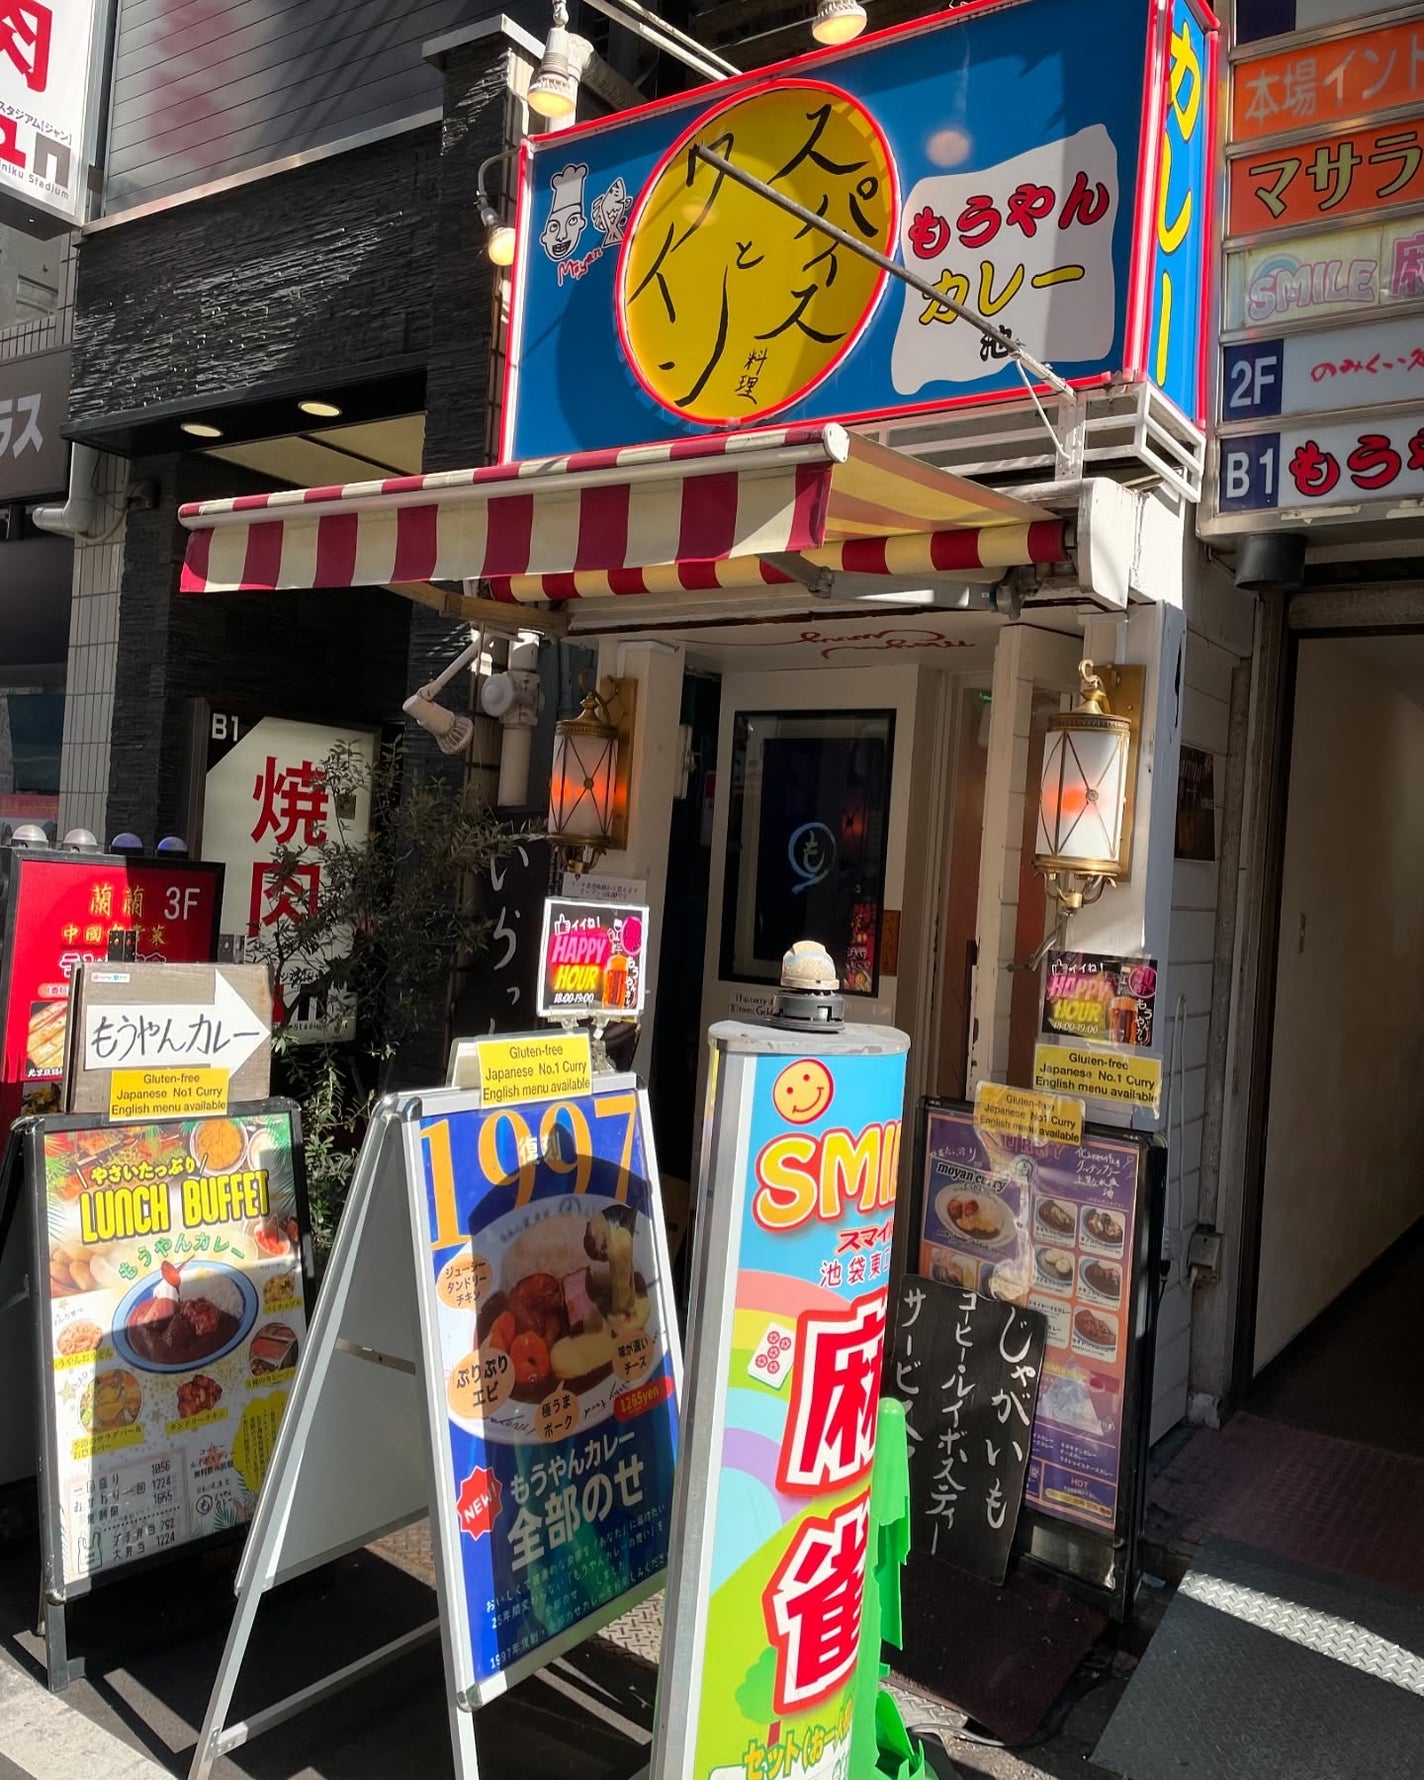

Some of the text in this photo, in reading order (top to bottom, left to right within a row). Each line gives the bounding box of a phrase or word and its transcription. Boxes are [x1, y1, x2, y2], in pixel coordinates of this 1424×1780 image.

[1249, 130, 1424, 219] マサラ
[908, 170, 1110, 260] もうやん
[918, 260, 1085, 326] カレー
[1248, 259, 1378, 321] SMILE
[733, 347, 770, 405] 料理
[1230, 355, 1278, 408] 2F
[1226, 447, 1275, 499] B1
[212, 713, 239, 742] B1
[249, 755, 331, 939] 焼肉
[164, 887, 200, 920] 3F
[551, 935, 606, 964] HAPPY
[554, 964, 600, 990] HOUR
[1054, 999, 1101, 1022] HOUR
[91, 1013, 260, 1061] もうやんカレー
[509, 1044, 563, 1060] Gluten-free
[1069, 1053, 1129, 1070] Gluten-free
[143, 1074, 200, 1085] Gluten-free
[485, 1060, 587, 1082] Japanese No.1 Curry
[1040, 1064, 1092, 1080] Japanese
[1126, 1076, 1155, 1090] Curry
[117, 1086, 223, 1101] Japanese No1 Curry
[483, 1077, 591, 1103] English menu available
[1035, 1076, 1157, 1103] English menu available
[111, 1100, 226, 1117] English menu available
[984, 1104, 1025, 1119] Japanese
[1051, 1116, 1076, 1130] Curry
[980, 1115, 1011, 1128] English
[1039, 1128, 1080, 1143] available
[91, 1156, 195, 1186] やさいたっぷり
[419, 1094, 637, 1251] 1997
[937, 1163, 974, 1181] moyan
[80, 1170, 271, 1244] LUNCH BUFFET
[119, 1233, 245, 1281] もうやんカレー
[445, 1262, 487, 1279] ジューシー
[447, 1276, 487, 1294] タンドリー
[456, 1291, 480, 1306] チキン
[456, 1354, 508, 1389] ぷりぷり
[472, 1382, 499, 1407] エビ
[620, 1386, 659, 1412] 1265yen
[986, 1306, 1036, 1530] じゃがいも
[509, 1431, 635, 1505] もうやんカレー
[507, 1453, 645, 1573] 全部のせ
